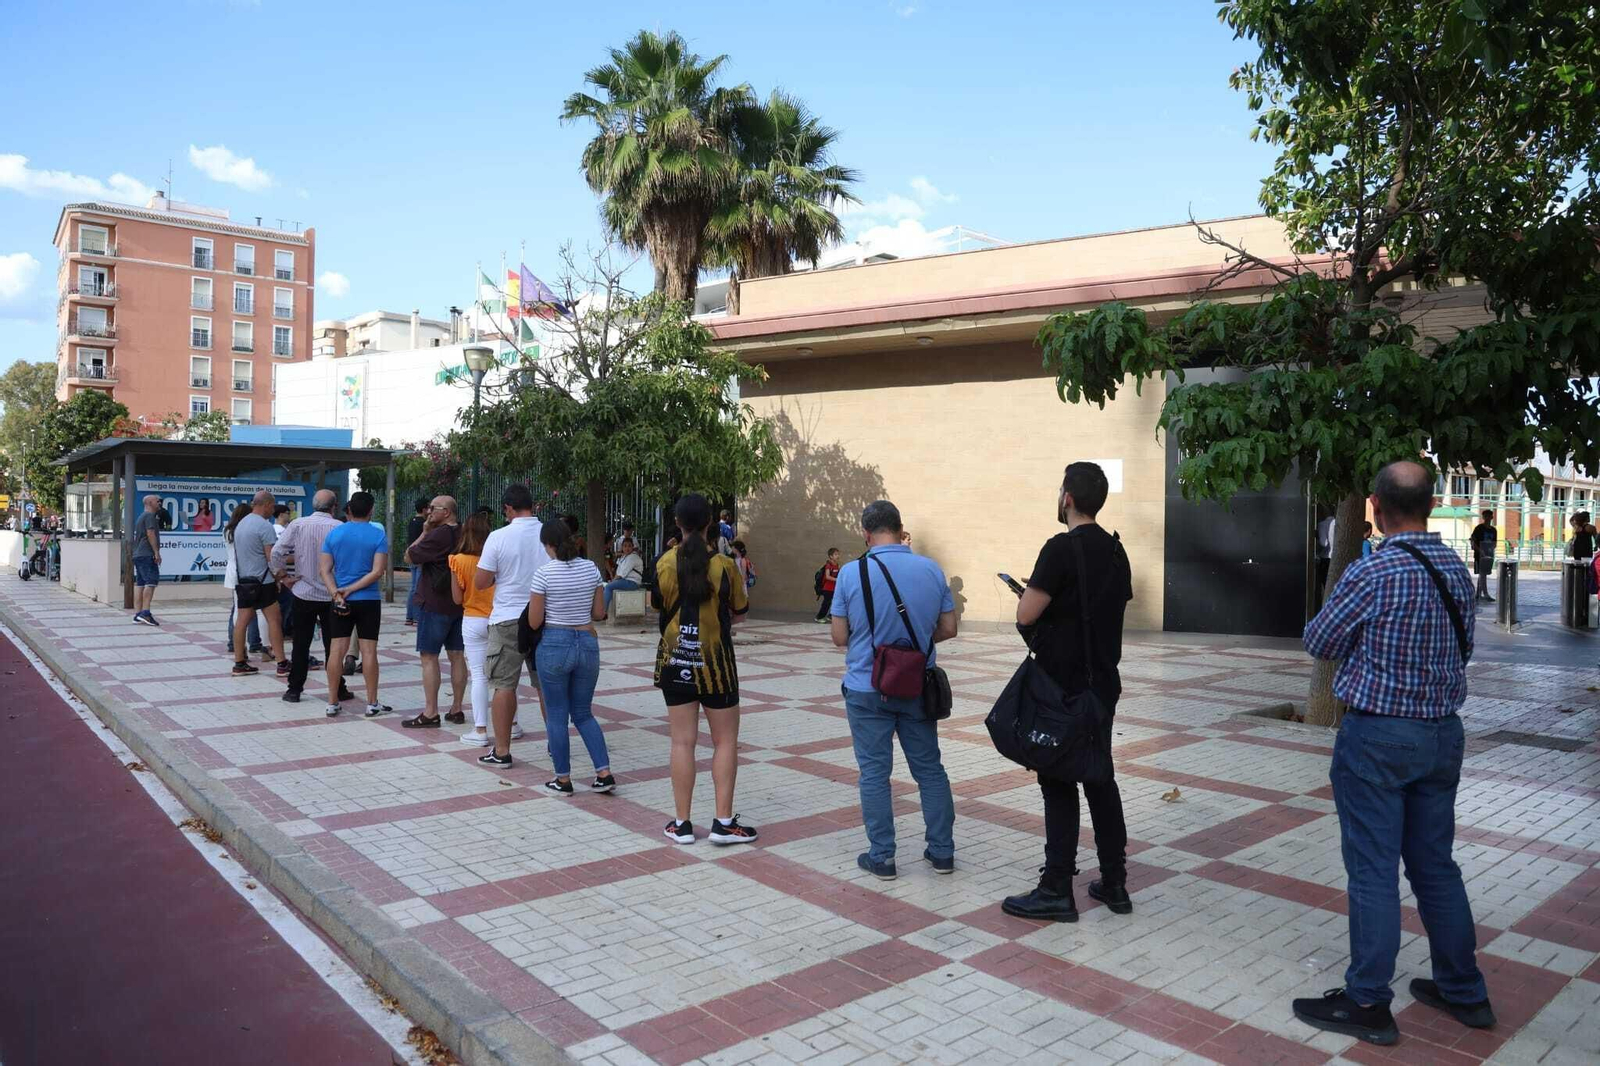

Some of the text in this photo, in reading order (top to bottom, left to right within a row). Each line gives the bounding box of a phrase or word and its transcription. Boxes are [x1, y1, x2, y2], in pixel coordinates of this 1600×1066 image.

[233, 486, 254, 494] plazas
[159, 540, 227, 549] azteFuncionari
[209, 560, 228, 568] Jesú
[680, 623, 698, 635] raíz
